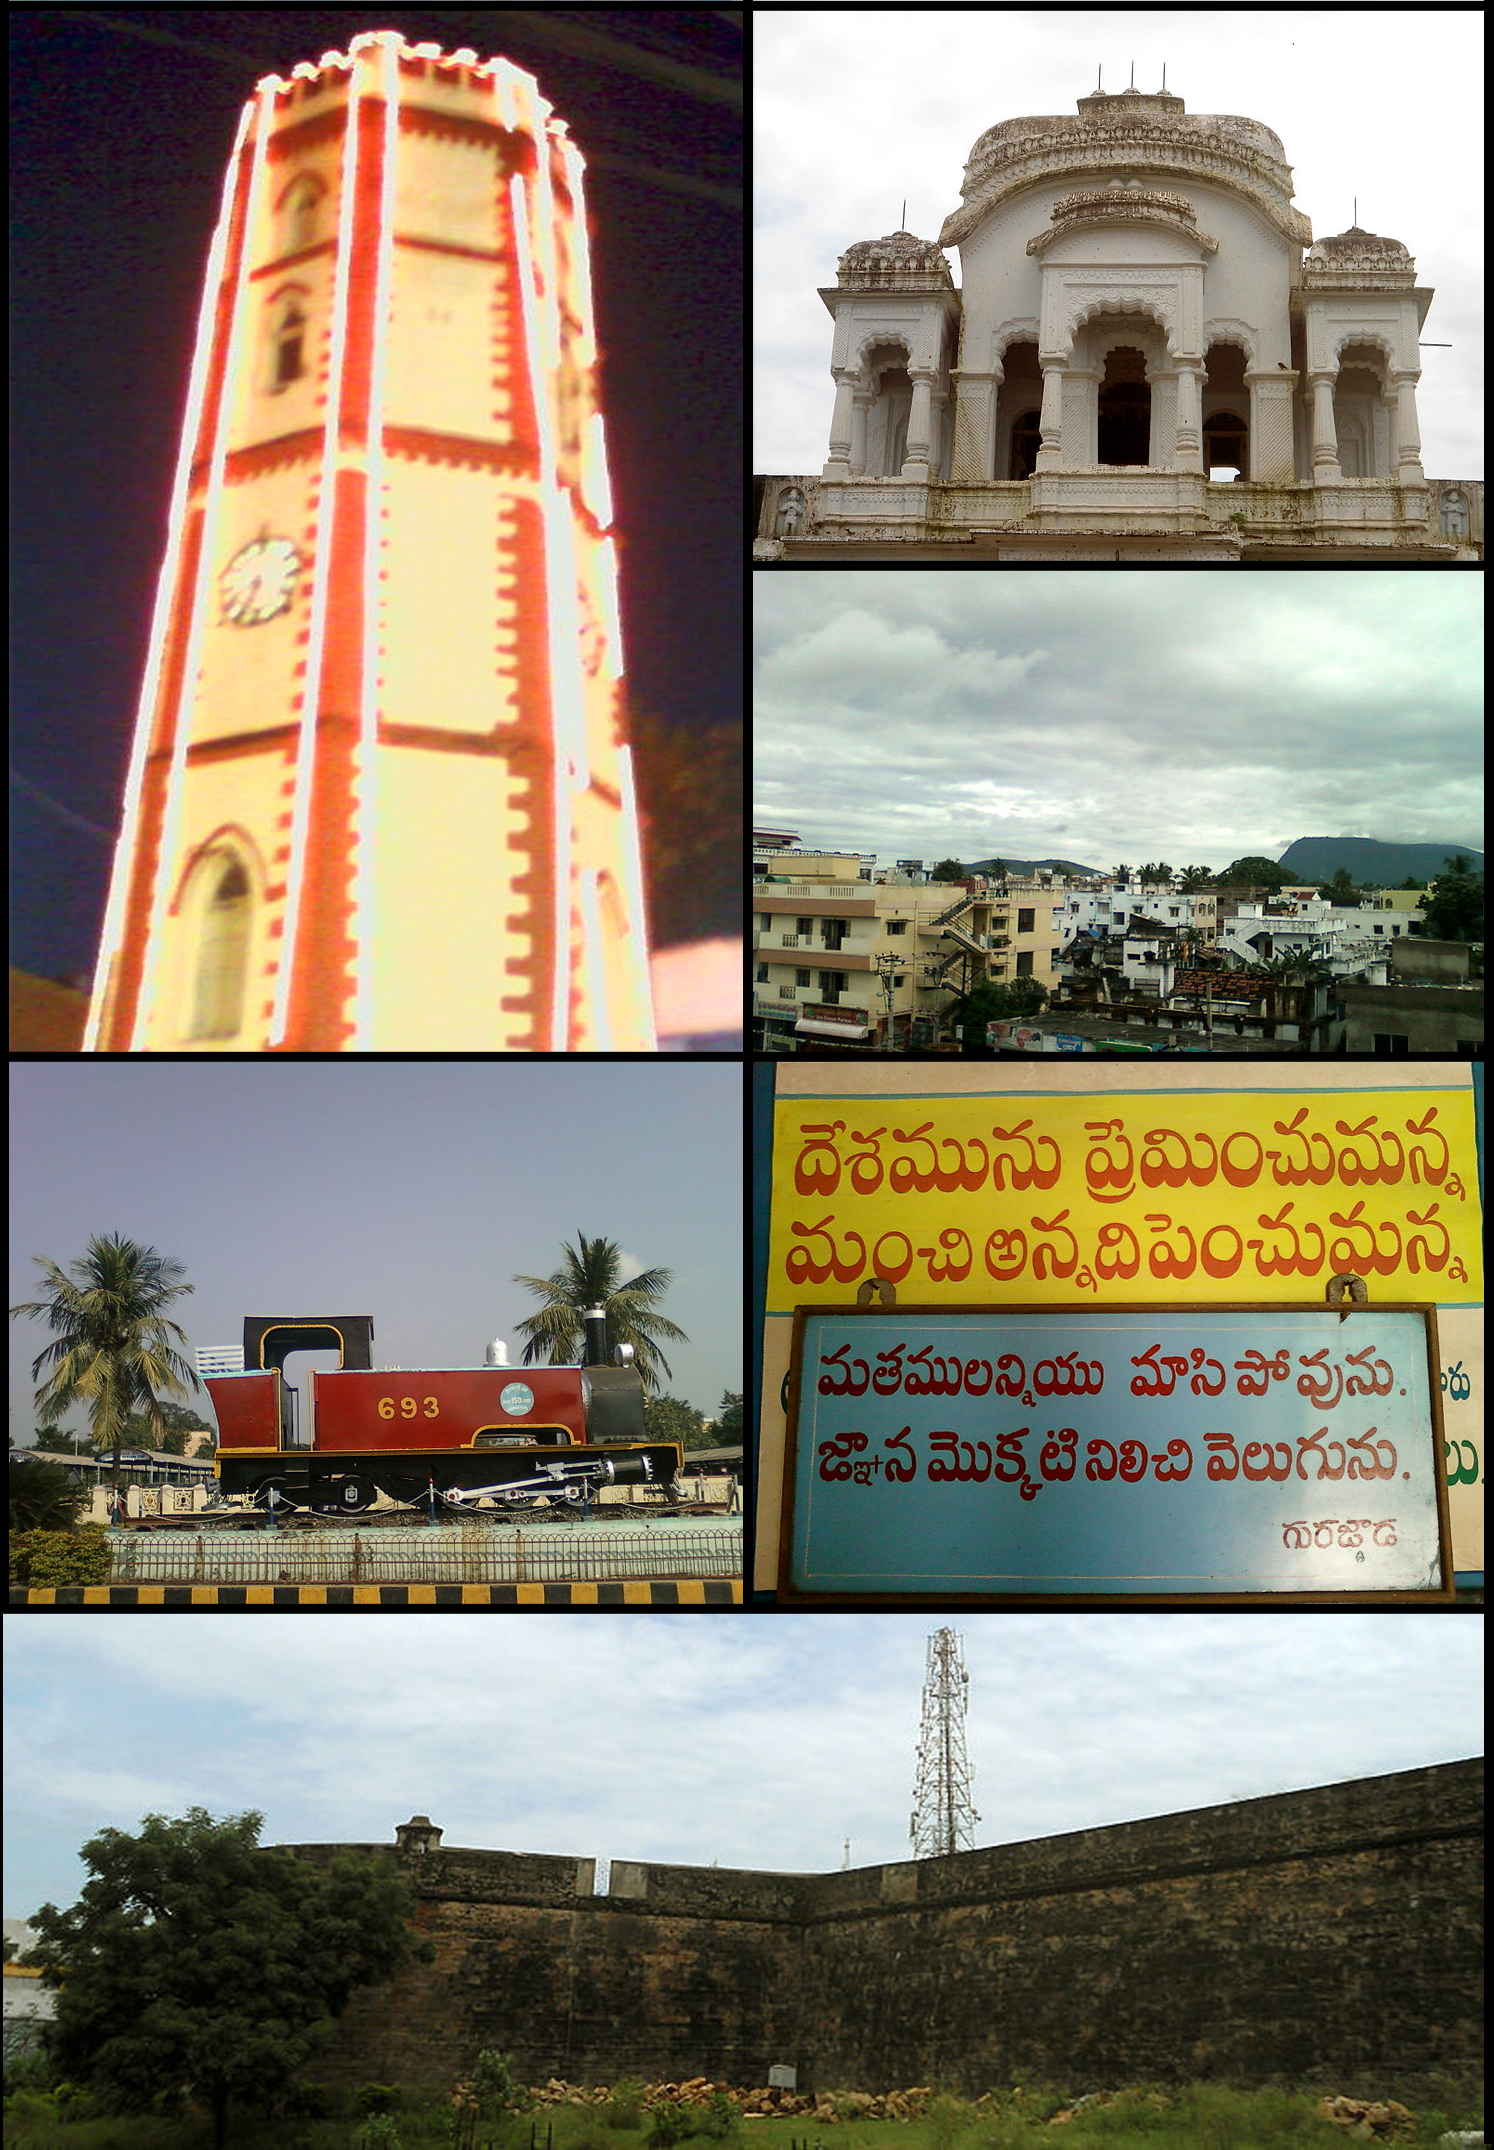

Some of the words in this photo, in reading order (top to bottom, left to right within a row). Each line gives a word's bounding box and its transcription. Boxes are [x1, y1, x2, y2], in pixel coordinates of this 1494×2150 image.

[795, 1119, 1062, 1196] దేశమును
[1084, 1107, 1466, 1204] ప్రేమించుమన్న
[786, 1214, 973, 1285] మంచి
[378, 1396, 440, 1420] 693
[818, 1344, 1105, 1407] మతములన్నియు
